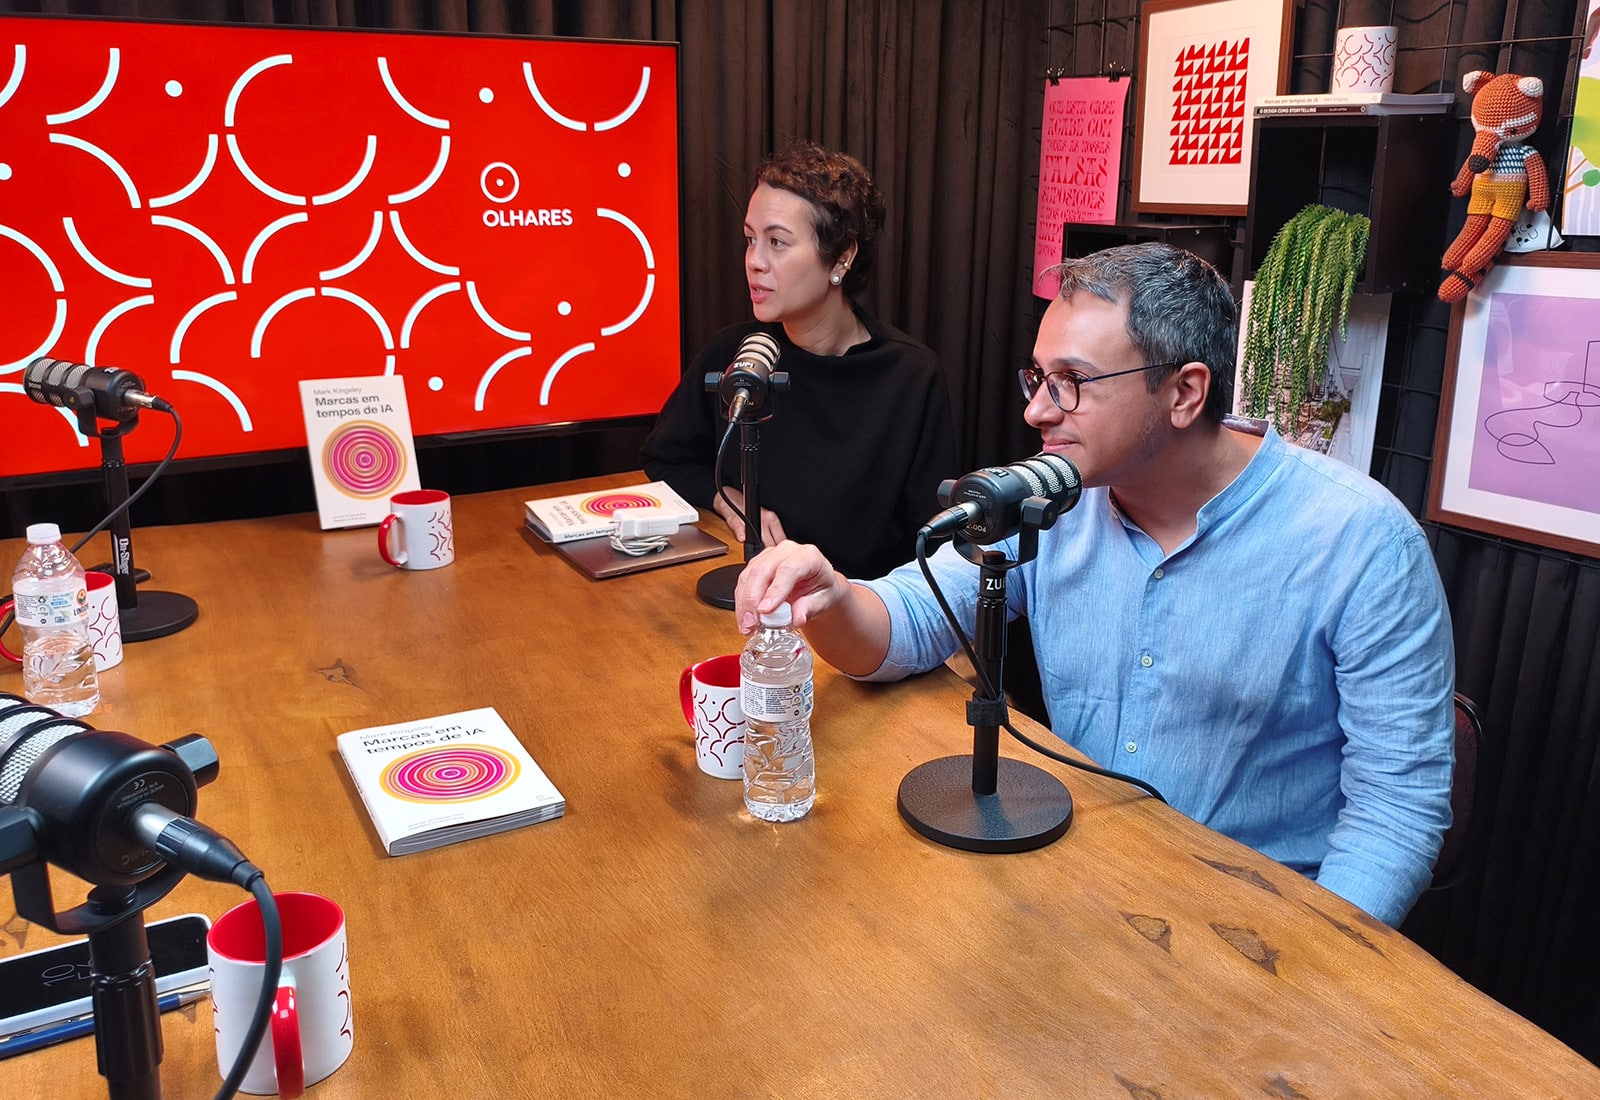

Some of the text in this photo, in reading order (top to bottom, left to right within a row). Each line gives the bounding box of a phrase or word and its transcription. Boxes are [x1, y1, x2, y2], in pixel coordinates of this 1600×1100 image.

[1047, 118, 1112, 138] ACABE COM
[1043, 155, 1108, 188] FALSAS
[482, 208, 573, 227] OLHARES
[315, 395, 380, 406] Marcas em
[317, 404, 394, 419] tempos de IA
[119, 537, 130, 576] On-Stage
[363, 725, 462, 747] Marcas em
[367, 728, 486, 754] tempos de IA
